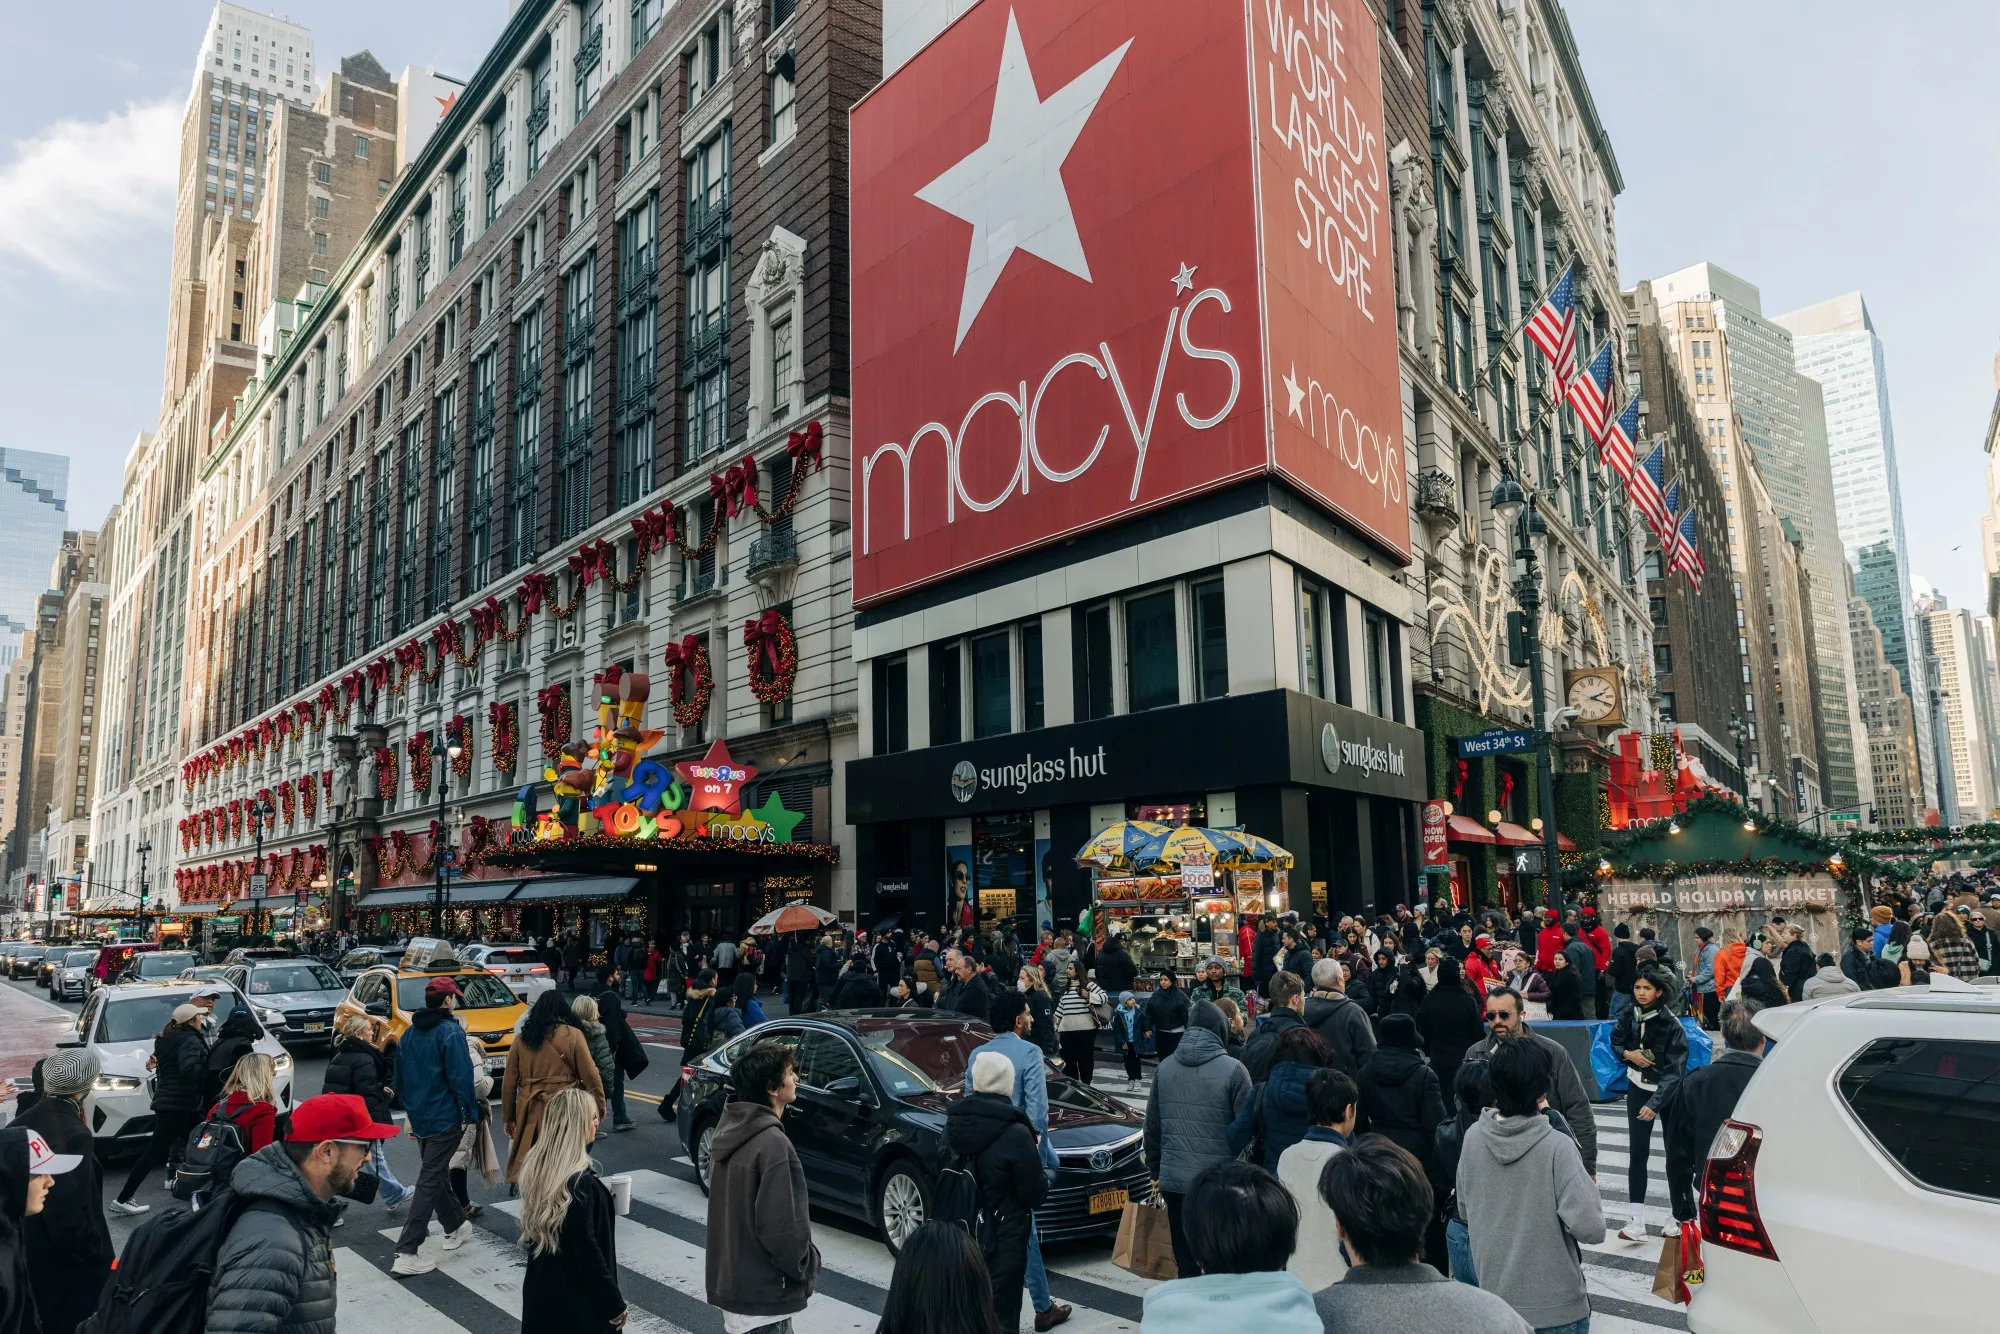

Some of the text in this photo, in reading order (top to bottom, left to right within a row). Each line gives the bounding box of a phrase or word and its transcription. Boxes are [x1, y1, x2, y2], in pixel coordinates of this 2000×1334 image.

[1265, 0, 1379, 192] WORLD'S
[1268, 60, 1380, 258] LARGEST
[1294, 177, 1375, 324] STORE
[1464, 735, 1526, 752] West 34th St
[1341, 736, 1406, 778] sunglass hut
[980, 745, 1108, 795] sunglass hut
[704, 783, 733, 794] on 7
[1423, 834, 1446, 844] OPEN
[1424, 826, 1444, 836] NOW
[252, 884, 265, 892] 25
[1677, 875, 1760, 886] GREETINGS FROM
[1607, 887, 1838, 905] HERALD HOLIDAY MARKET
